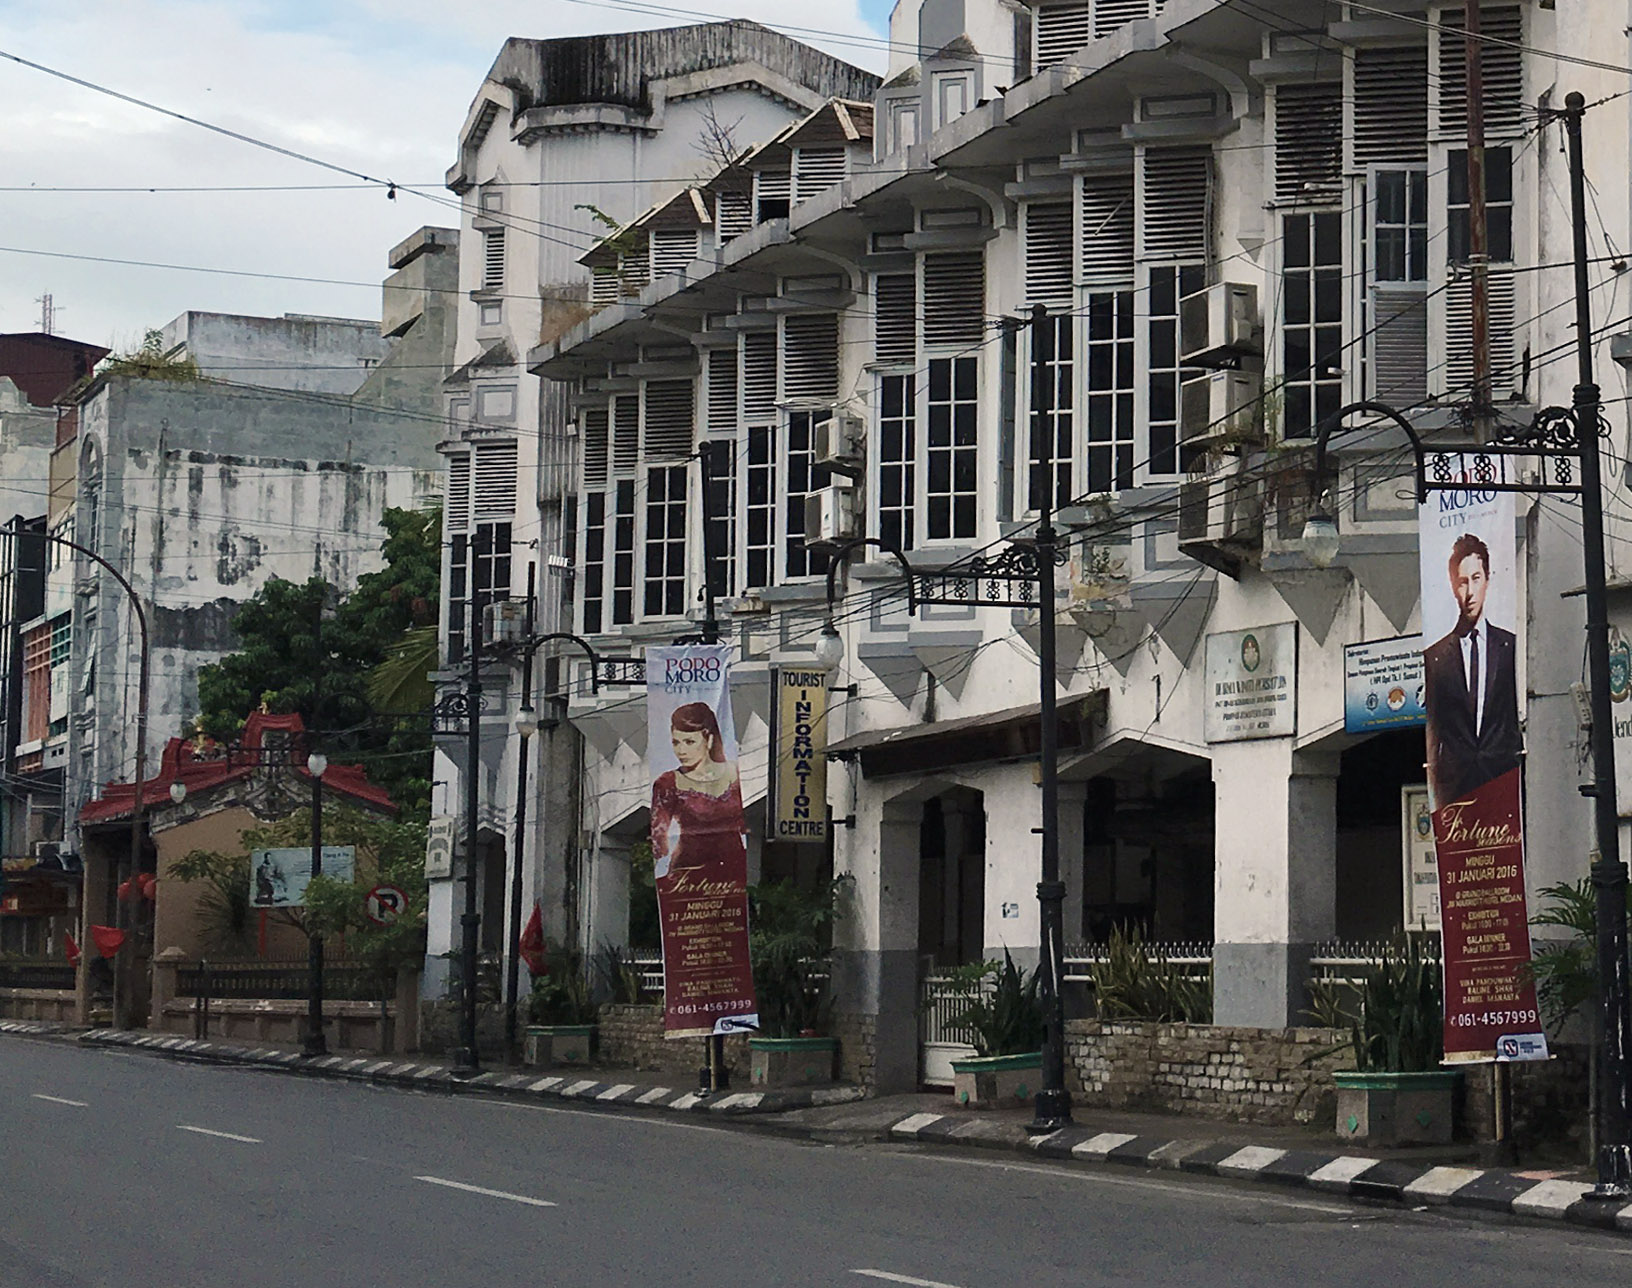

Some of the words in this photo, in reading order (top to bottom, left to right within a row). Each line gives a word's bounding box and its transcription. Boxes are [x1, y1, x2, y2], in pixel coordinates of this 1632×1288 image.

[1440, 489, 1497, 513] MORO
[1439, 512, 1467, 529] CITY
[666, 656, 720, 671] PODO
[666, 669, 720, 684] MORO
[783, 671, 826, 688] TOURIST
[793, 689, 813, 819] INFORMATION
[780, 820, 824, 836] CENTRE
[1465, 855, 1495, 867] MINGGU
[1446, 871, 1456, 884] 31
[1458, 867, 1495, 883] JANUARI
[1496, 865, 1518, 879] 2016
[678, 999, 752, 1015] 061-4567999
[1458, 1009, 1537, 1027] 061-4567999
